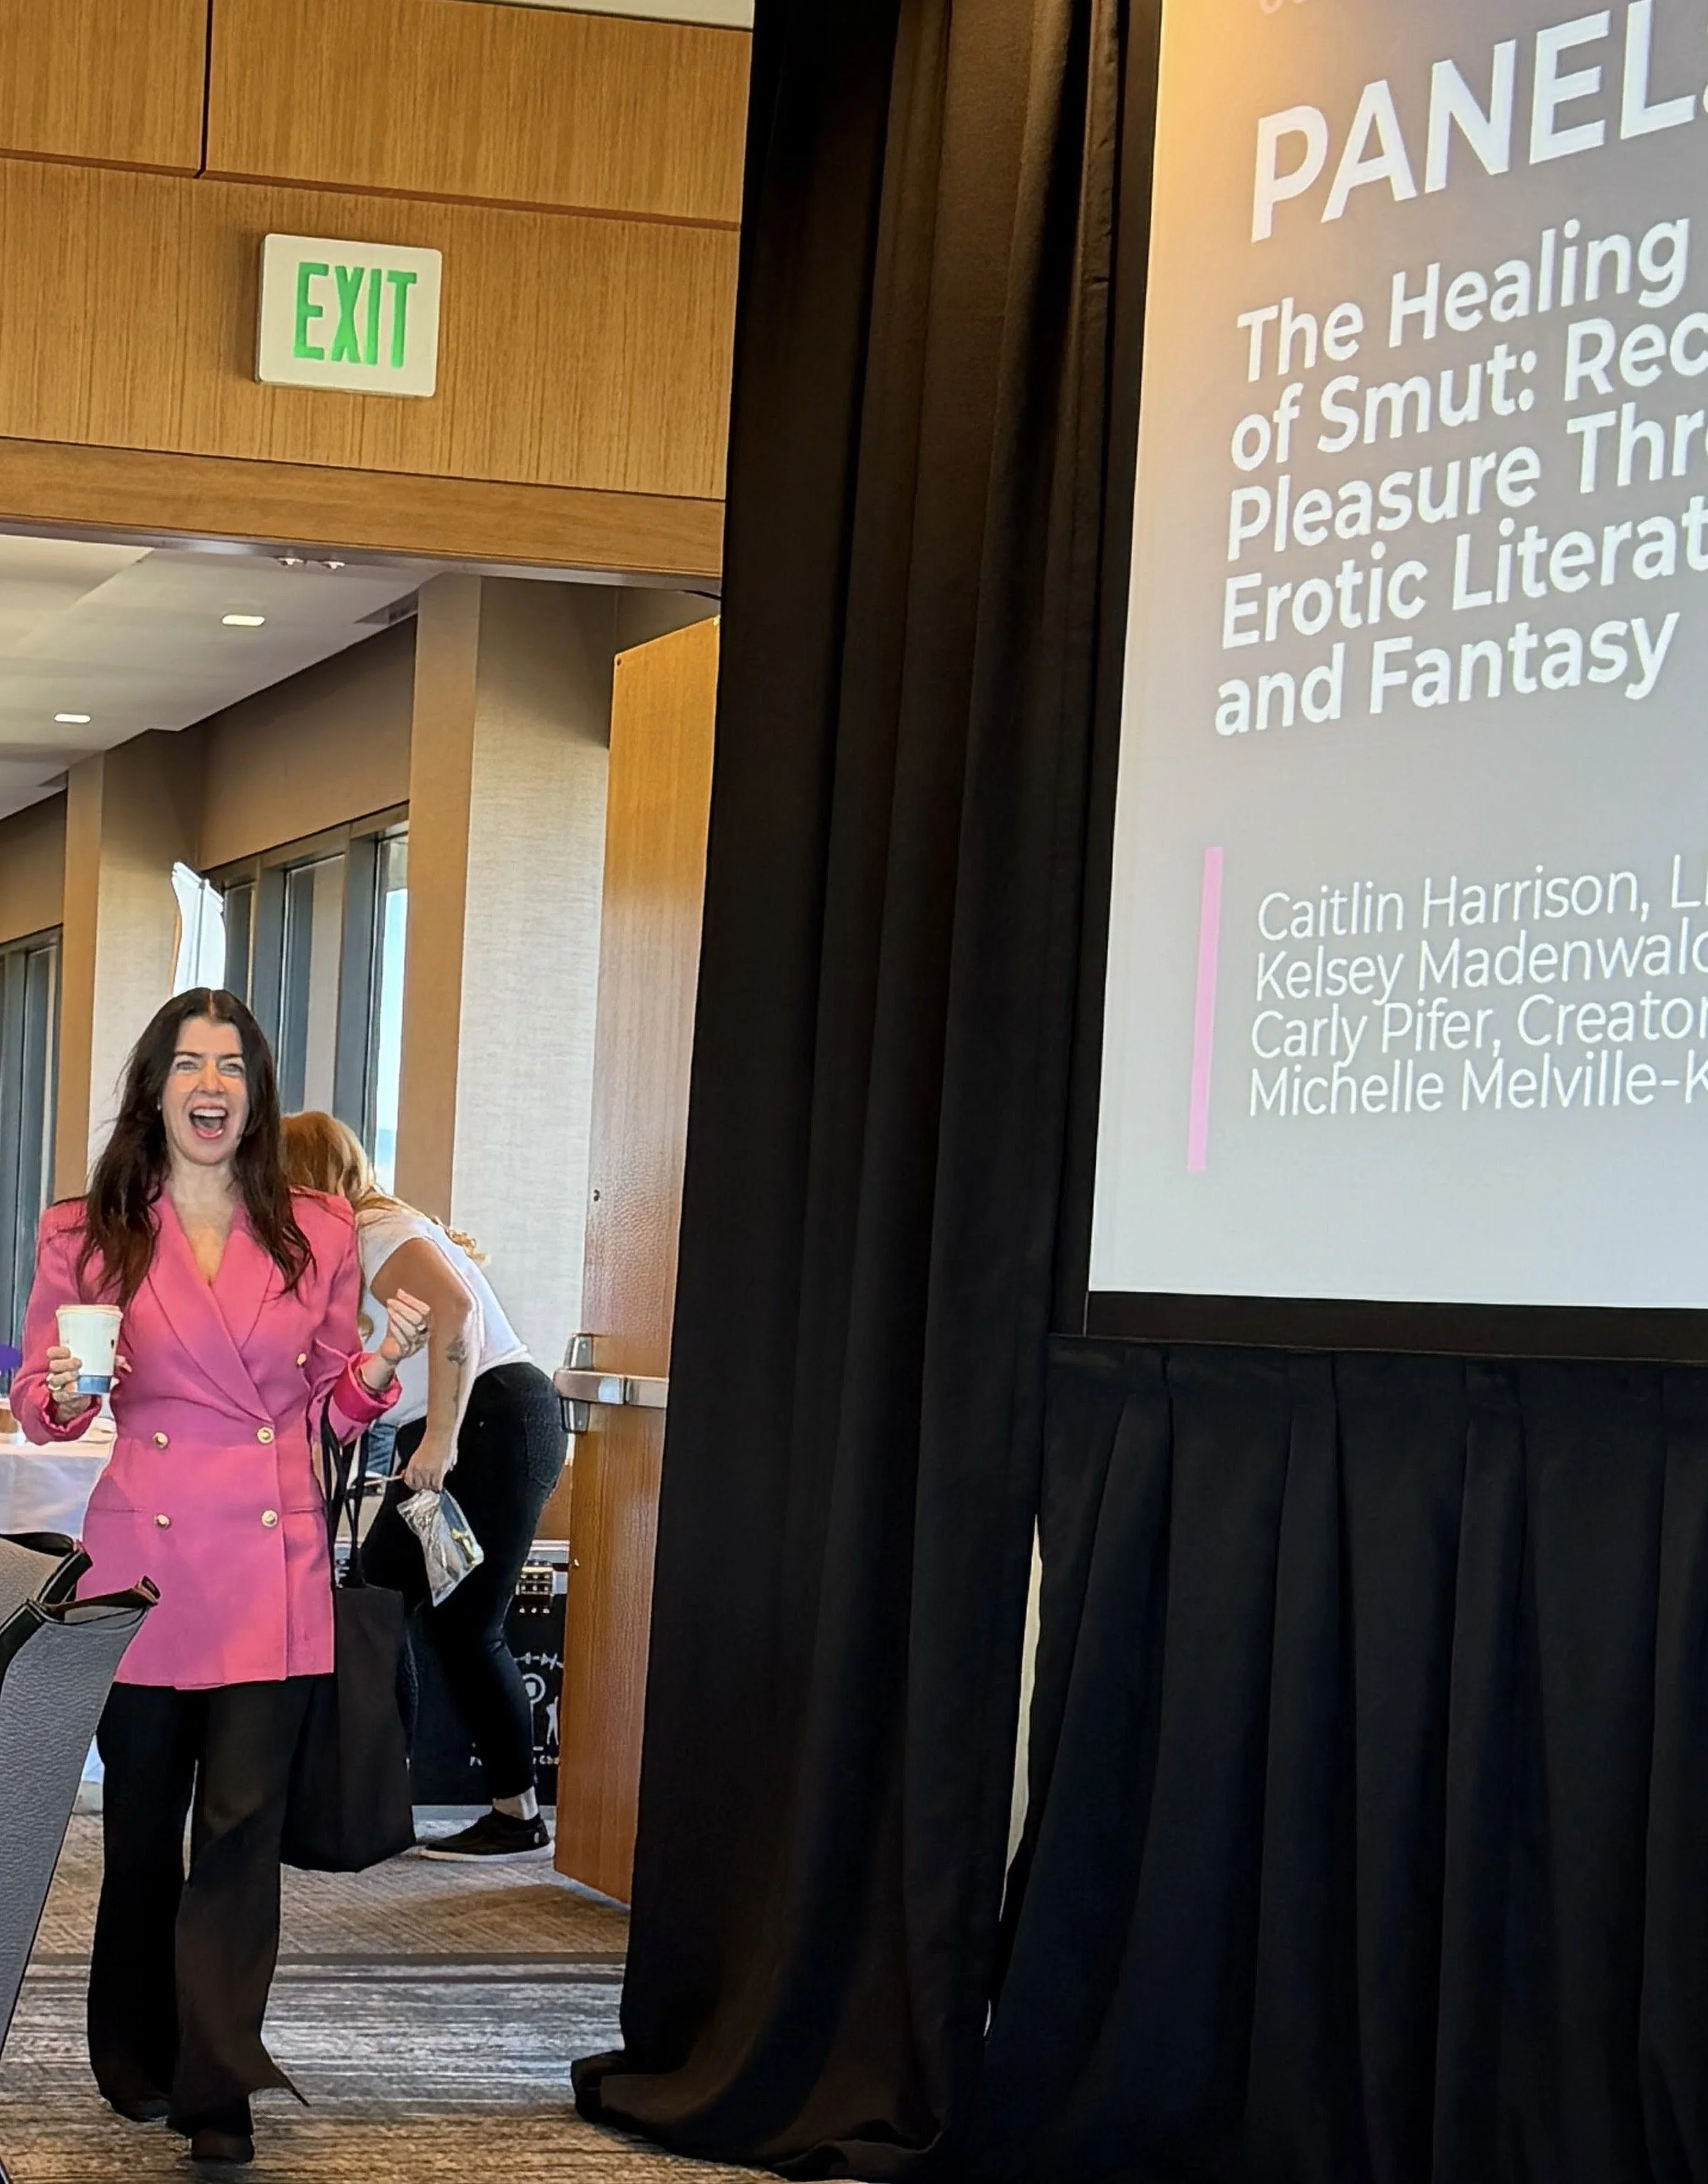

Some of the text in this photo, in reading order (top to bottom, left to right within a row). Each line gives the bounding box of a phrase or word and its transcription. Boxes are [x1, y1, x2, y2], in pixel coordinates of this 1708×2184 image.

[1251, 0, 1708, 243] PANEL
[294, 261, 417, 369] EXIT
[1235, 217, 1690, 383] The Healing
[1231, 311, 1708, 472] of Smut: Rec
[1227, 401, 1708, 562] Pleasure Thr
[1222, 495, 1708, 650] Erotic Literat
[1215, 611, 1681, 736] and Fantasy
[1257, 853, 1708, 942] Caitlin Harrison, L
[1251, 1002, 1368, 1068] Carly
[1381, 997, 1502, 1058] Pifer,
[1256, 944, 1405, 1006] Kelsey
[1249, 1048, 1708, 1117] Michelle Melville-K
